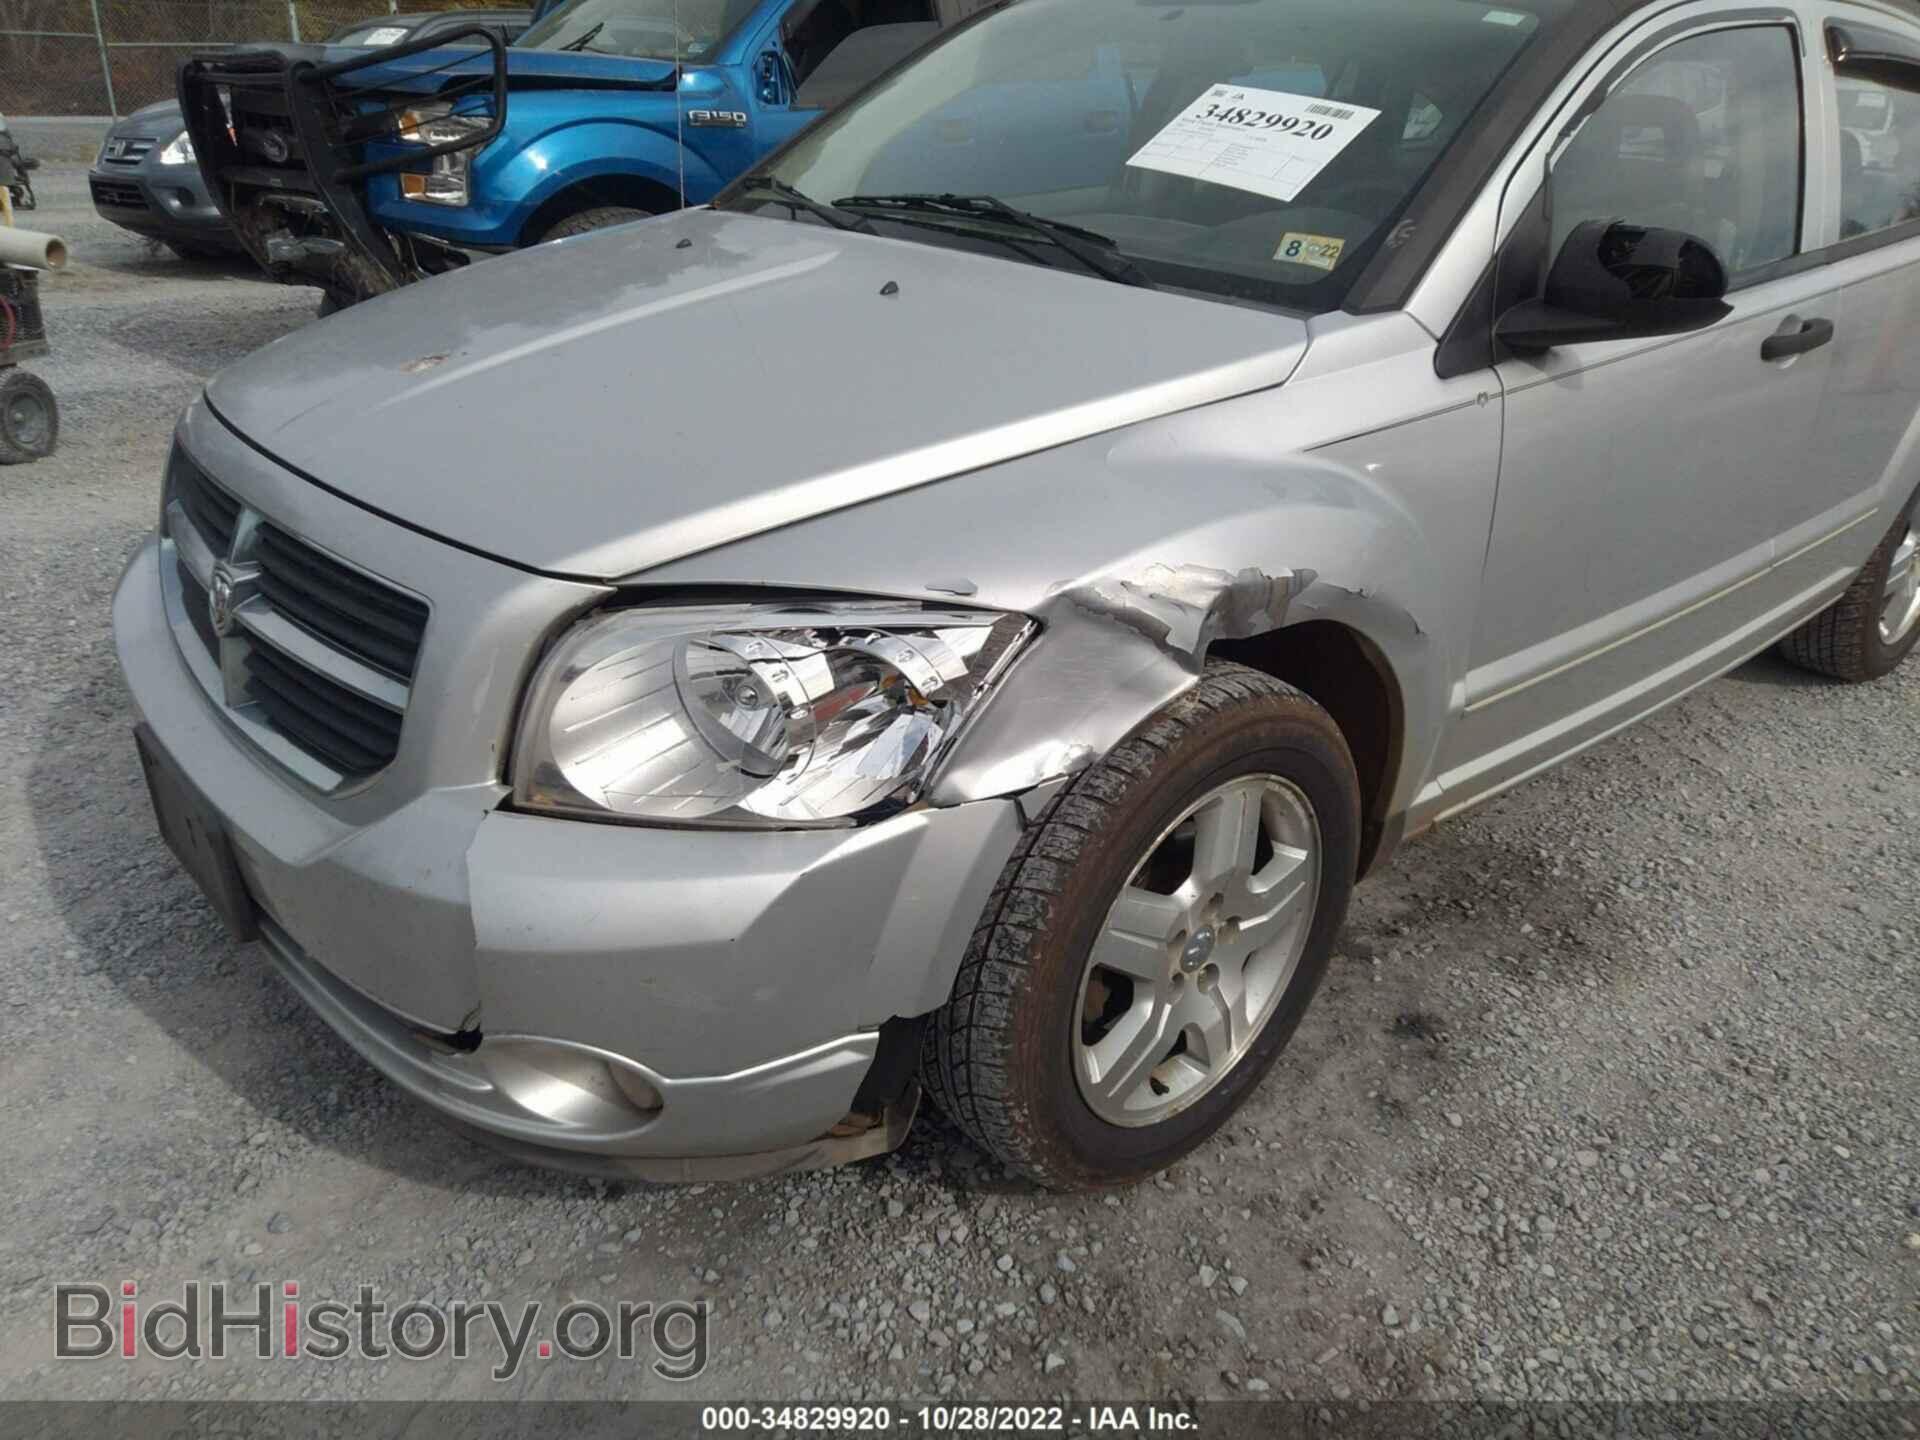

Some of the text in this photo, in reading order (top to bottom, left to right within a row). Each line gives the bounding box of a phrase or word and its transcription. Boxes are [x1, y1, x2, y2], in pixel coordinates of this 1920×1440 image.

[1195, 103, 1335, 141] 34829920
[1286, 239, 1340, 258] 8 22
